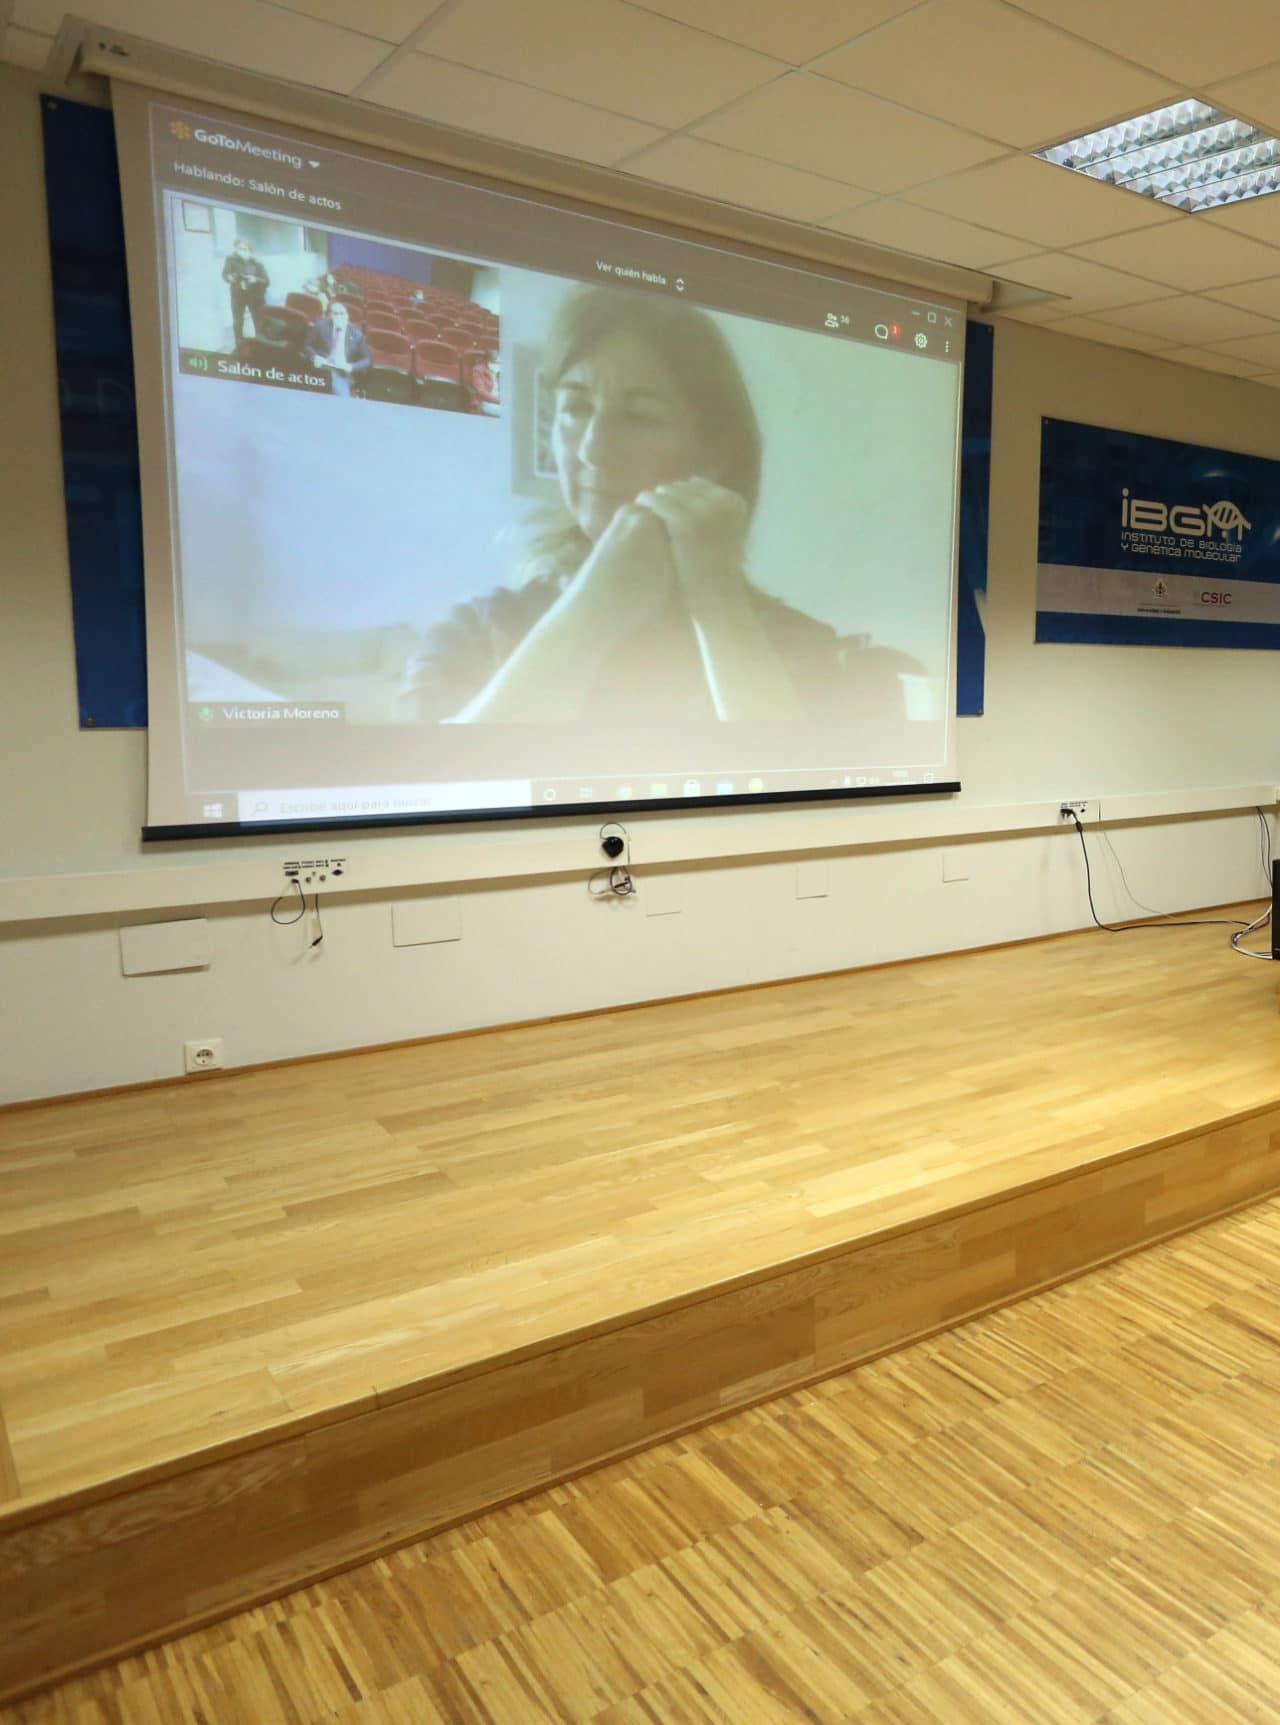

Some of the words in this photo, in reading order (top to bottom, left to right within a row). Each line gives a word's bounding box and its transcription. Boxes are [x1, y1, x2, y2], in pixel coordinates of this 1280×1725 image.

[194, 129, 302, 169] GoToMeeting
[173, 161, 245, 188] Hablando:
[248, 179, 285, 198] Salón
[288, 189, 305, 202] de
[309, 196, 342, 210] actos
[595, 260, 612, 273] Ver
[615, 266, 640, 279] quién
[642, 271, 666, 286] habla
[217, 360, 261, 377] Salón
[265, 367, 285, 380] de
[287, 371, 326, 387] actos
[1120, 543, 1129, 551] Y
[1121, 531, 1176, 546] INSTITUTO
[1179, 538, 1195, 548] DE
[1200, 591, 1233, 605] CSIC
[223, 707, 281, 720] Victoria
[283, 707, 340, 720] Moreno
